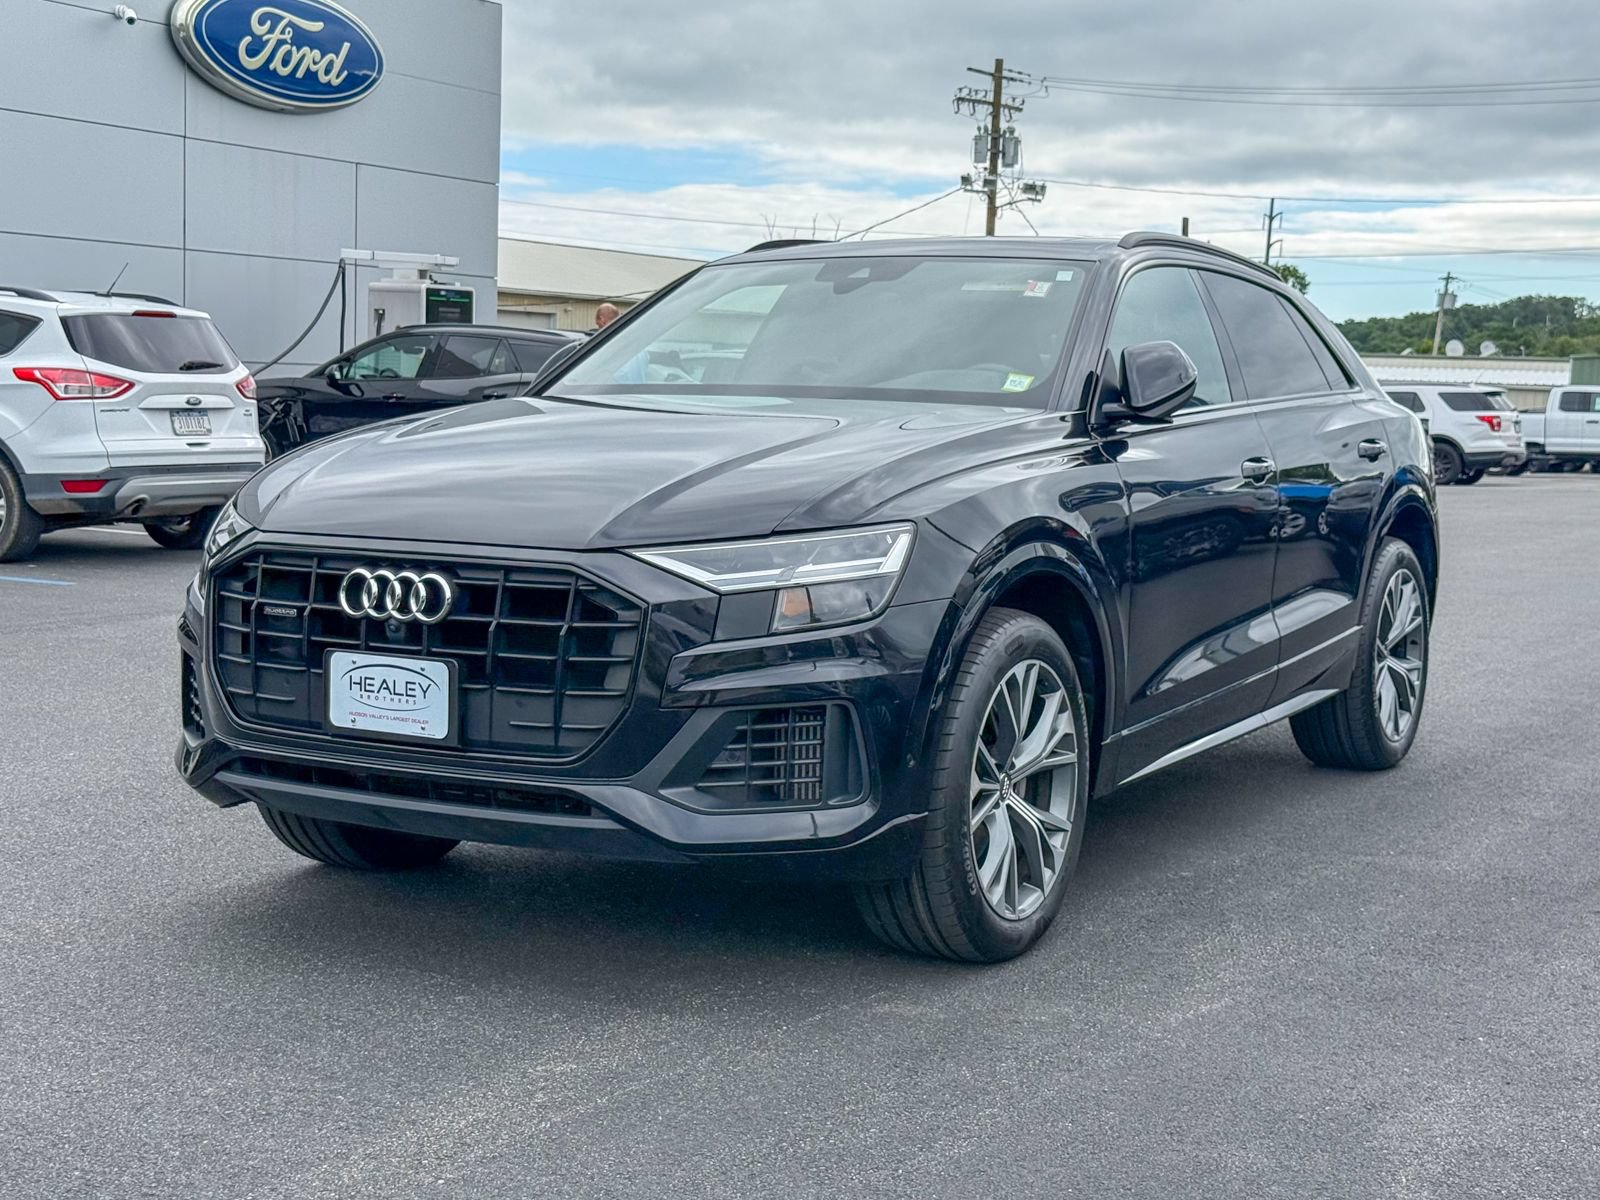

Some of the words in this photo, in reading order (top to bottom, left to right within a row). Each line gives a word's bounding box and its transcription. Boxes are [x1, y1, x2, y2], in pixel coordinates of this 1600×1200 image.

[238, 6, 351, 87] Ford
[349, 674, 432, 699] HEALEY
[359, 693, 417, 705] BROTHERS
[368, 713, 389, 721] VALLEY'S
[390, 715, 410, 723] LARGEST
